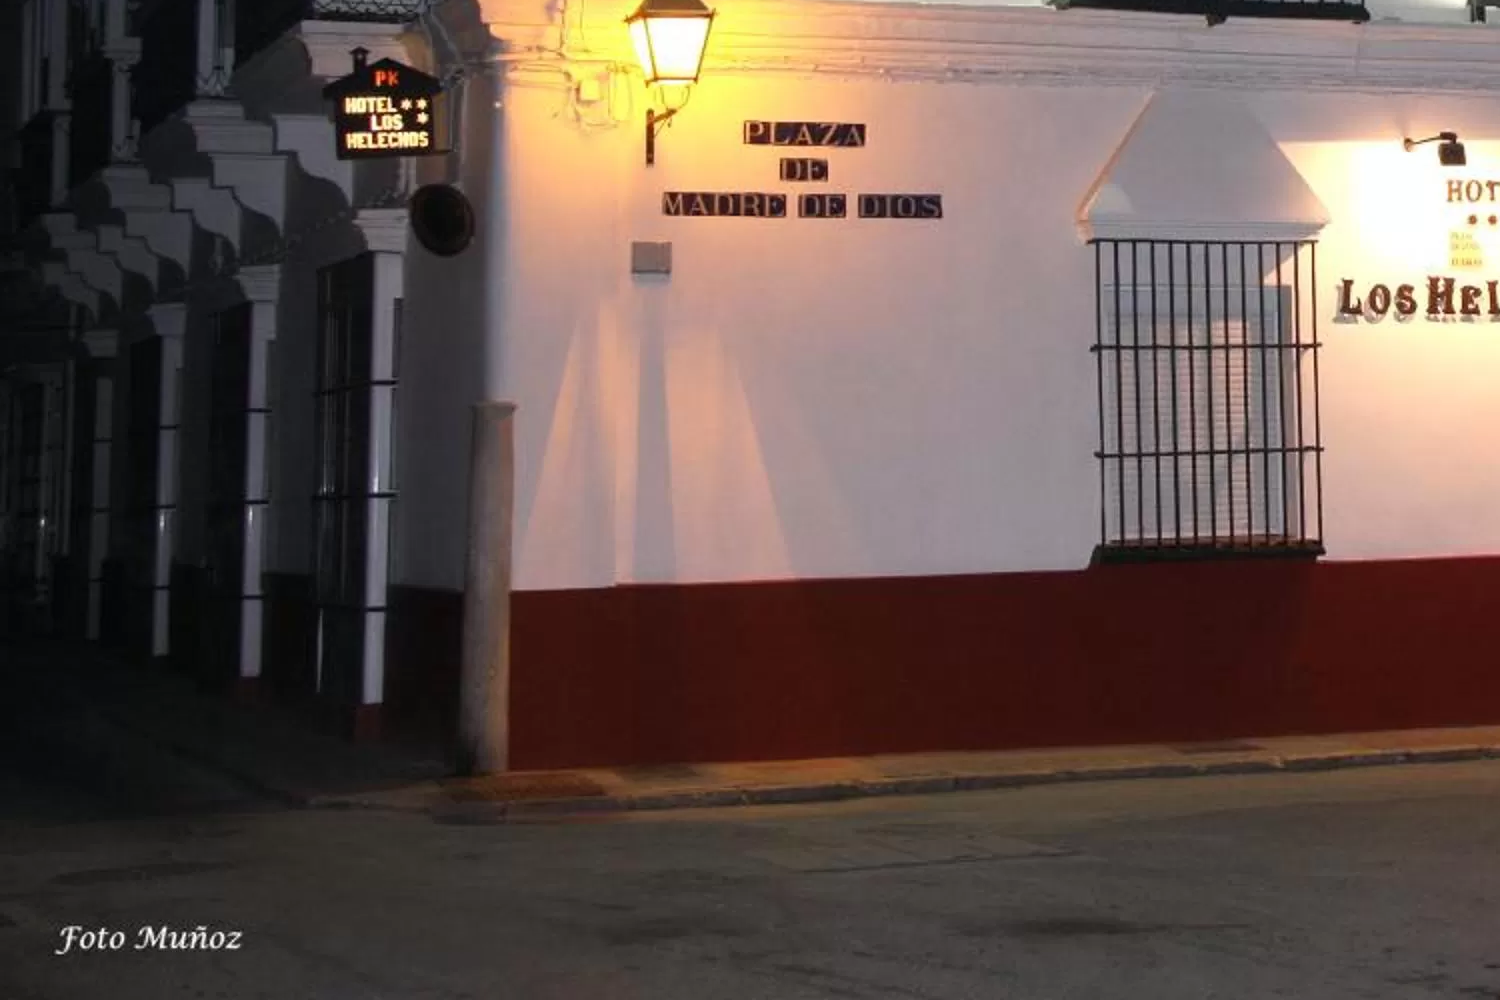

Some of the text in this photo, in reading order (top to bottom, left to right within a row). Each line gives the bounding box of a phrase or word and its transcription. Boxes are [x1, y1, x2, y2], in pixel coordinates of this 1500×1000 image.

[344, 96, 398, 113] HOTEL
[370, 114, 404, 131] LOS
[744, 120, 866, 147] PLAZA
[345, 131, 429, 149] HELECHOS
[780, 158, 828, 182] DE
[662, 191, 943, 218] MADRE DE DIOS
[1340, 277, 1418, 315] LOS
